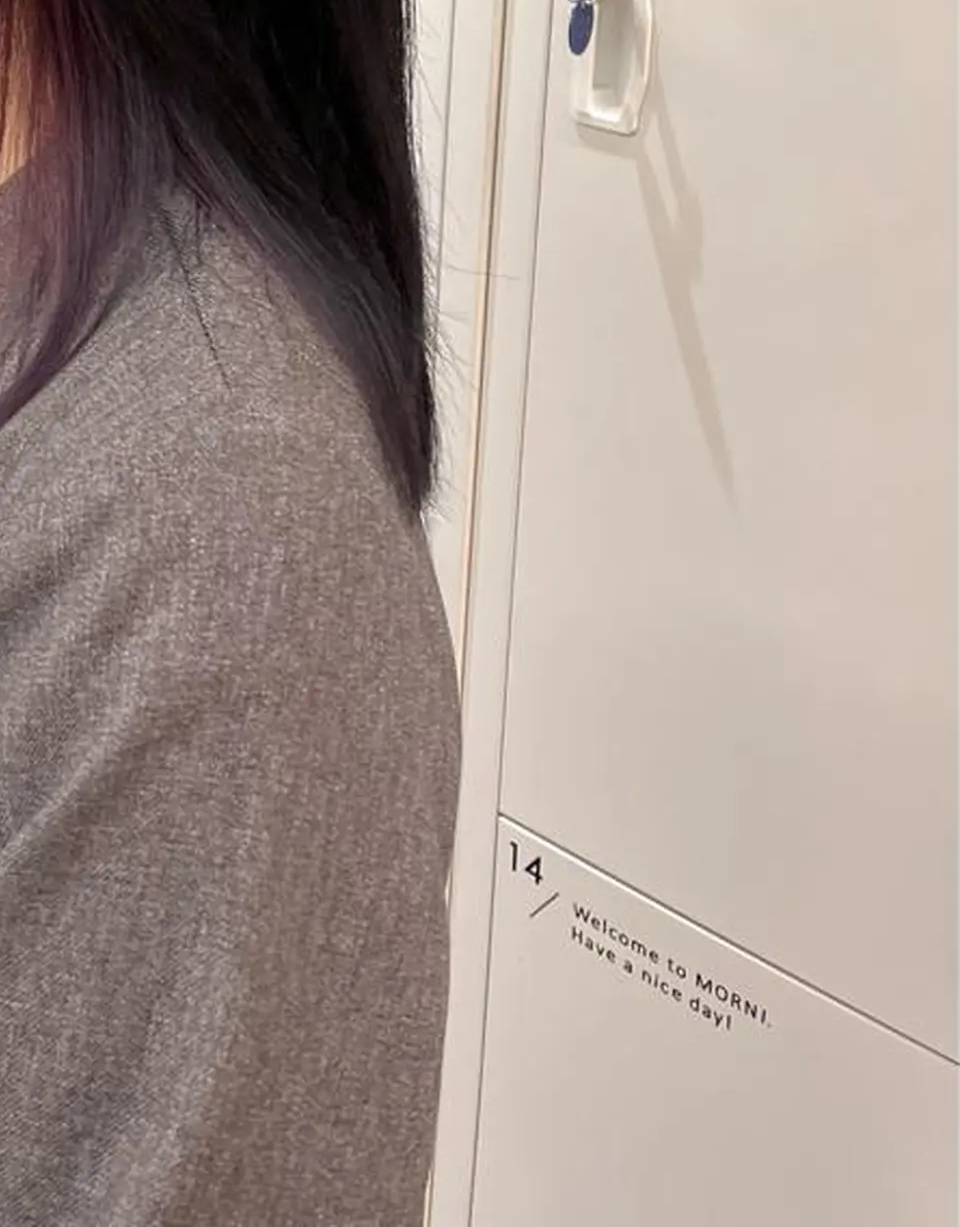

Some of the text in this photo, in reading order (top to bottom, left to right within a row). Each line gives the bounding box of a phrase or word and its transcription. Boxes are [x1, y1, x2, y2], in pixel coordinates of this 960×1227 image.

[509, 840, 544, 886] 14
[571, 925, 617, 964] Have
[622, 959, 634, 975] a
[641, 969, 683, 1003] nice
[572, 902, 659, 965] Welcome
[667, 957, 687, 980] to
